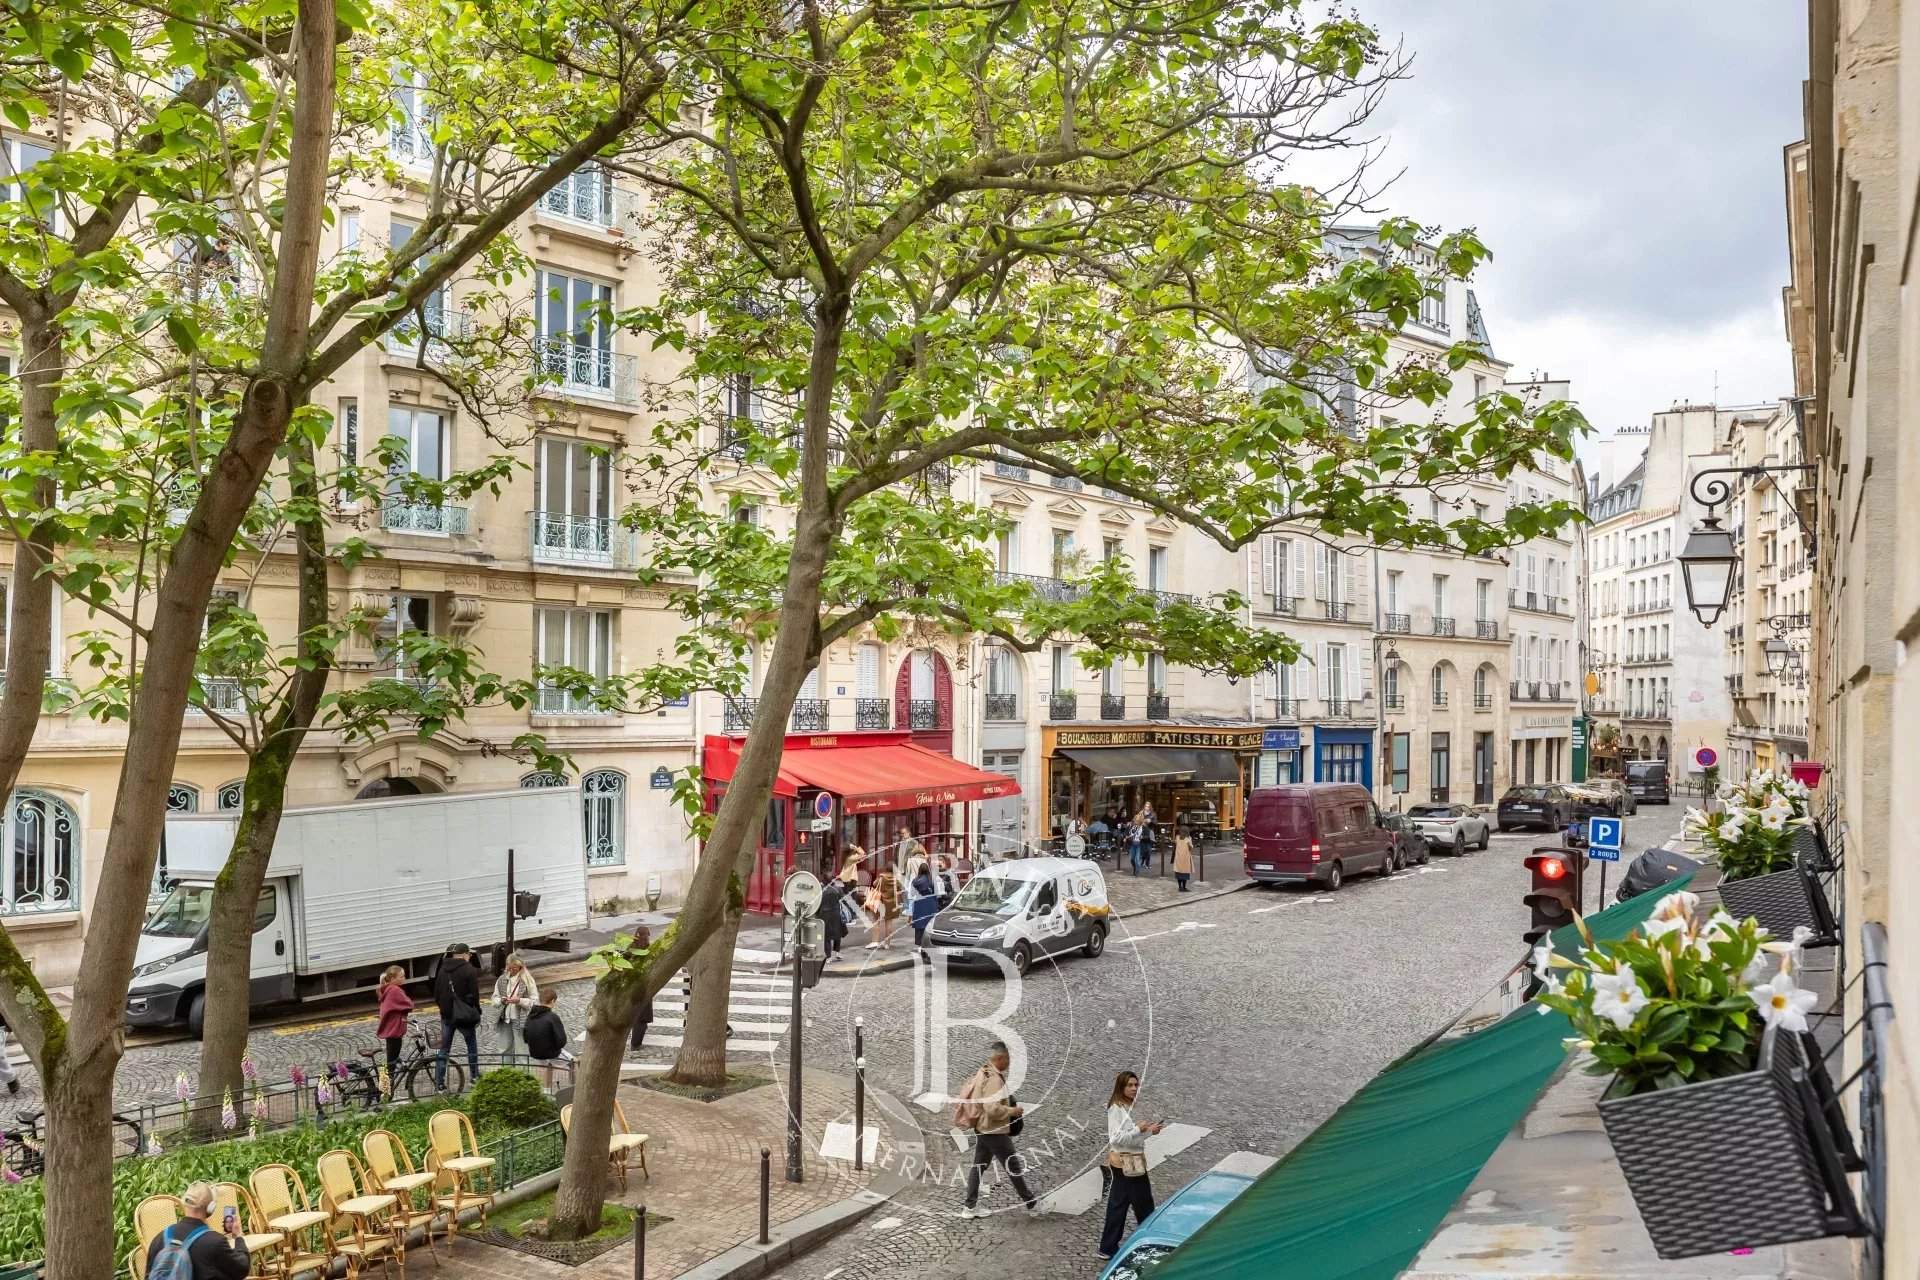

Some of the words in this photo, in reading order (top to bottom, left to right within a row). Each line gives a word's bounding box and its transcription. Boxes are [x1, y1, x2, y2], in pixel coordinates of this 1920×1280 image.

[1061, 732, 1110, 744] BOULANGERIE
[1111, 732, 1145, 744] MODERNE
[1154, 732, 1234, 746] PATISSERIE
[1599, 824, 1611, 840] P
